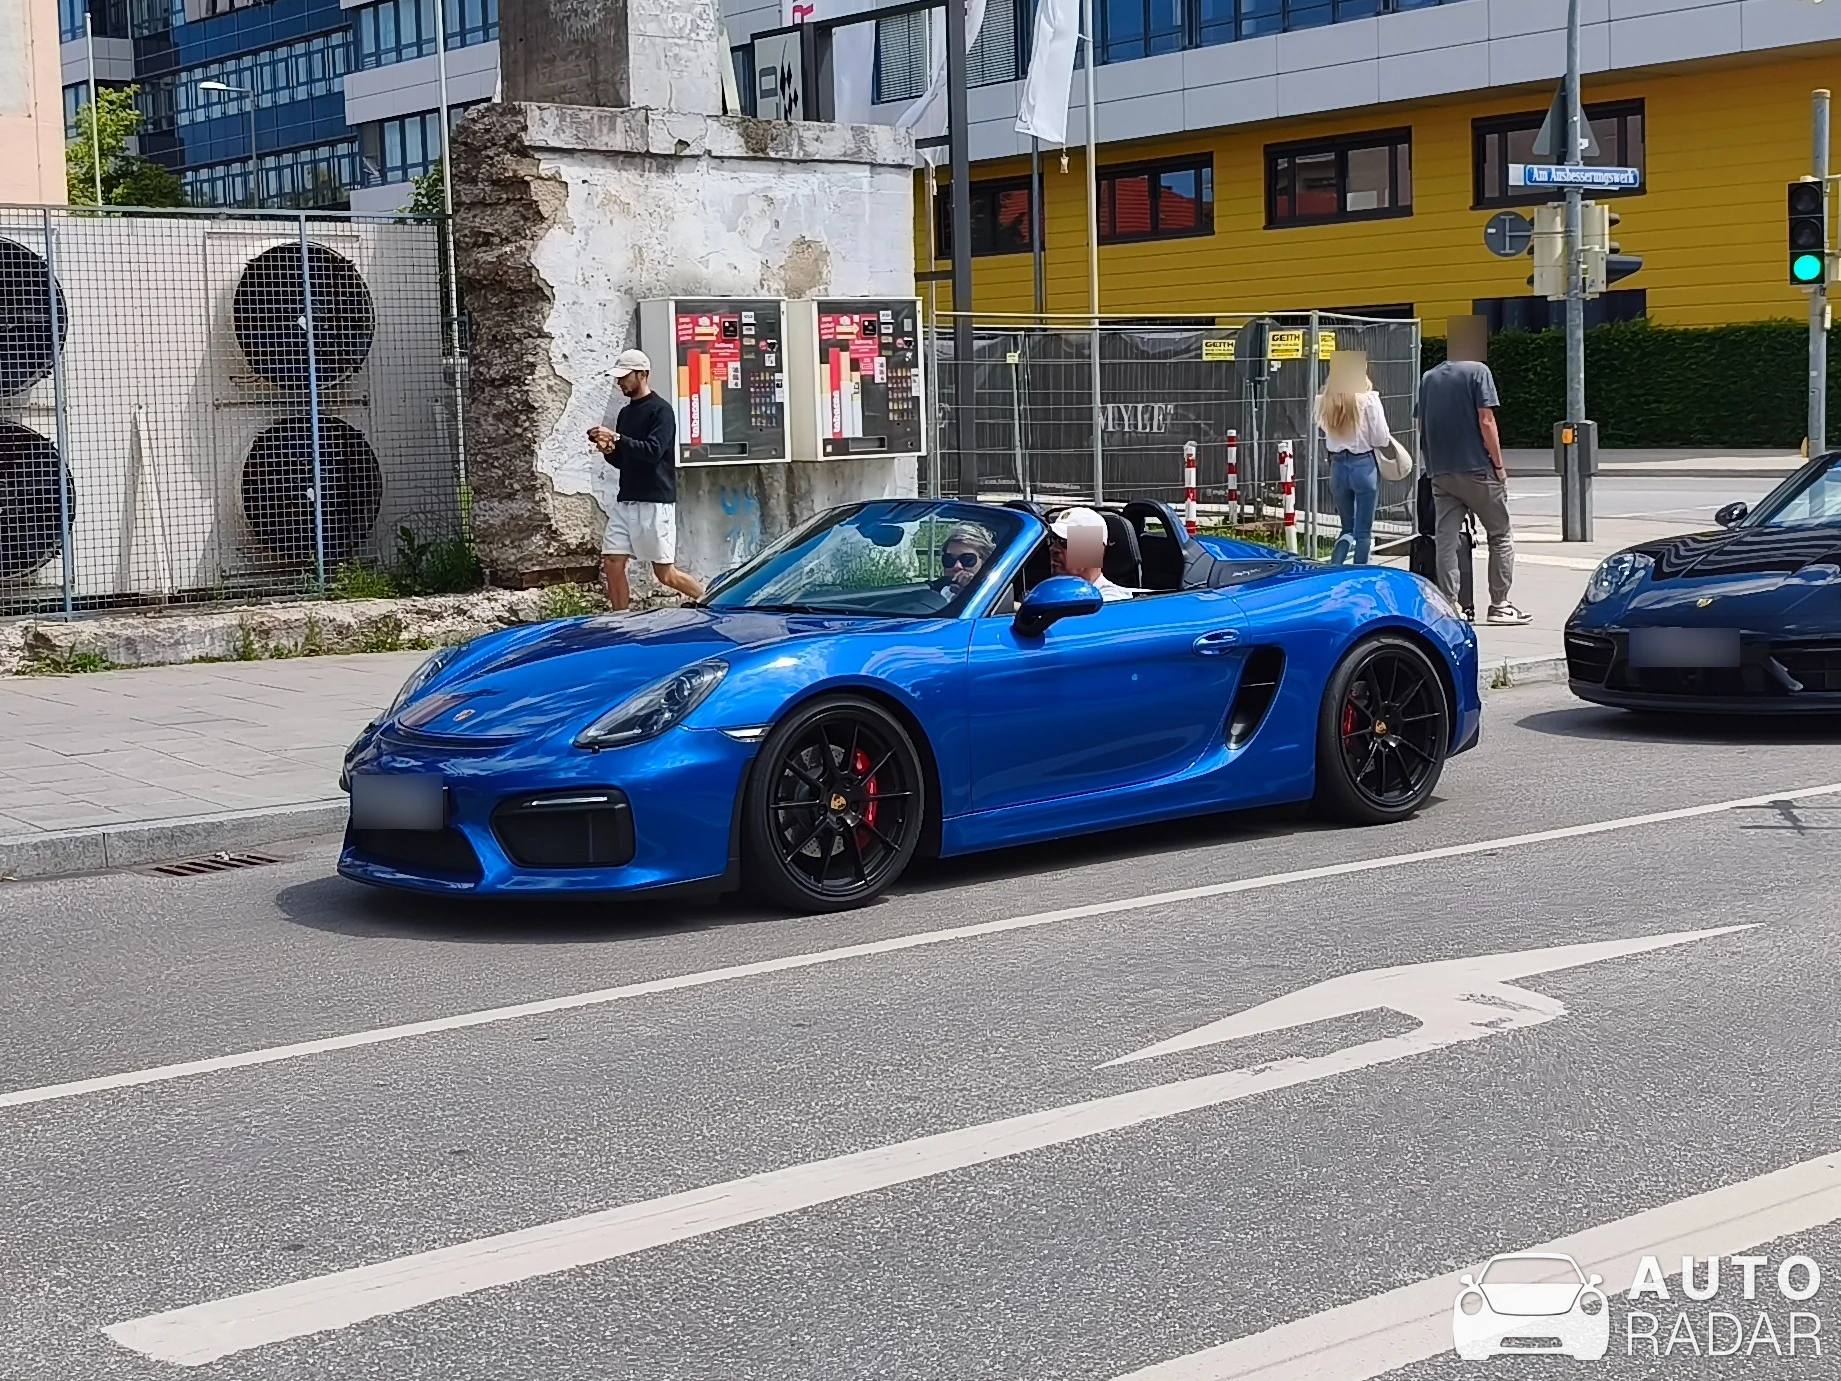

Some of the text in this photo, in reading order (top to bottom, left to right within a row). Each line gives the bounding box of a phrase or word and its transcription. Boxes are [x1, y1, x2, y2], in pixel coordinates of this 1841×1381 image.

[1532, 167, 1635, 186] Am Ausbesserungswerk
[1271, 333, 1300, 342] GEITH
